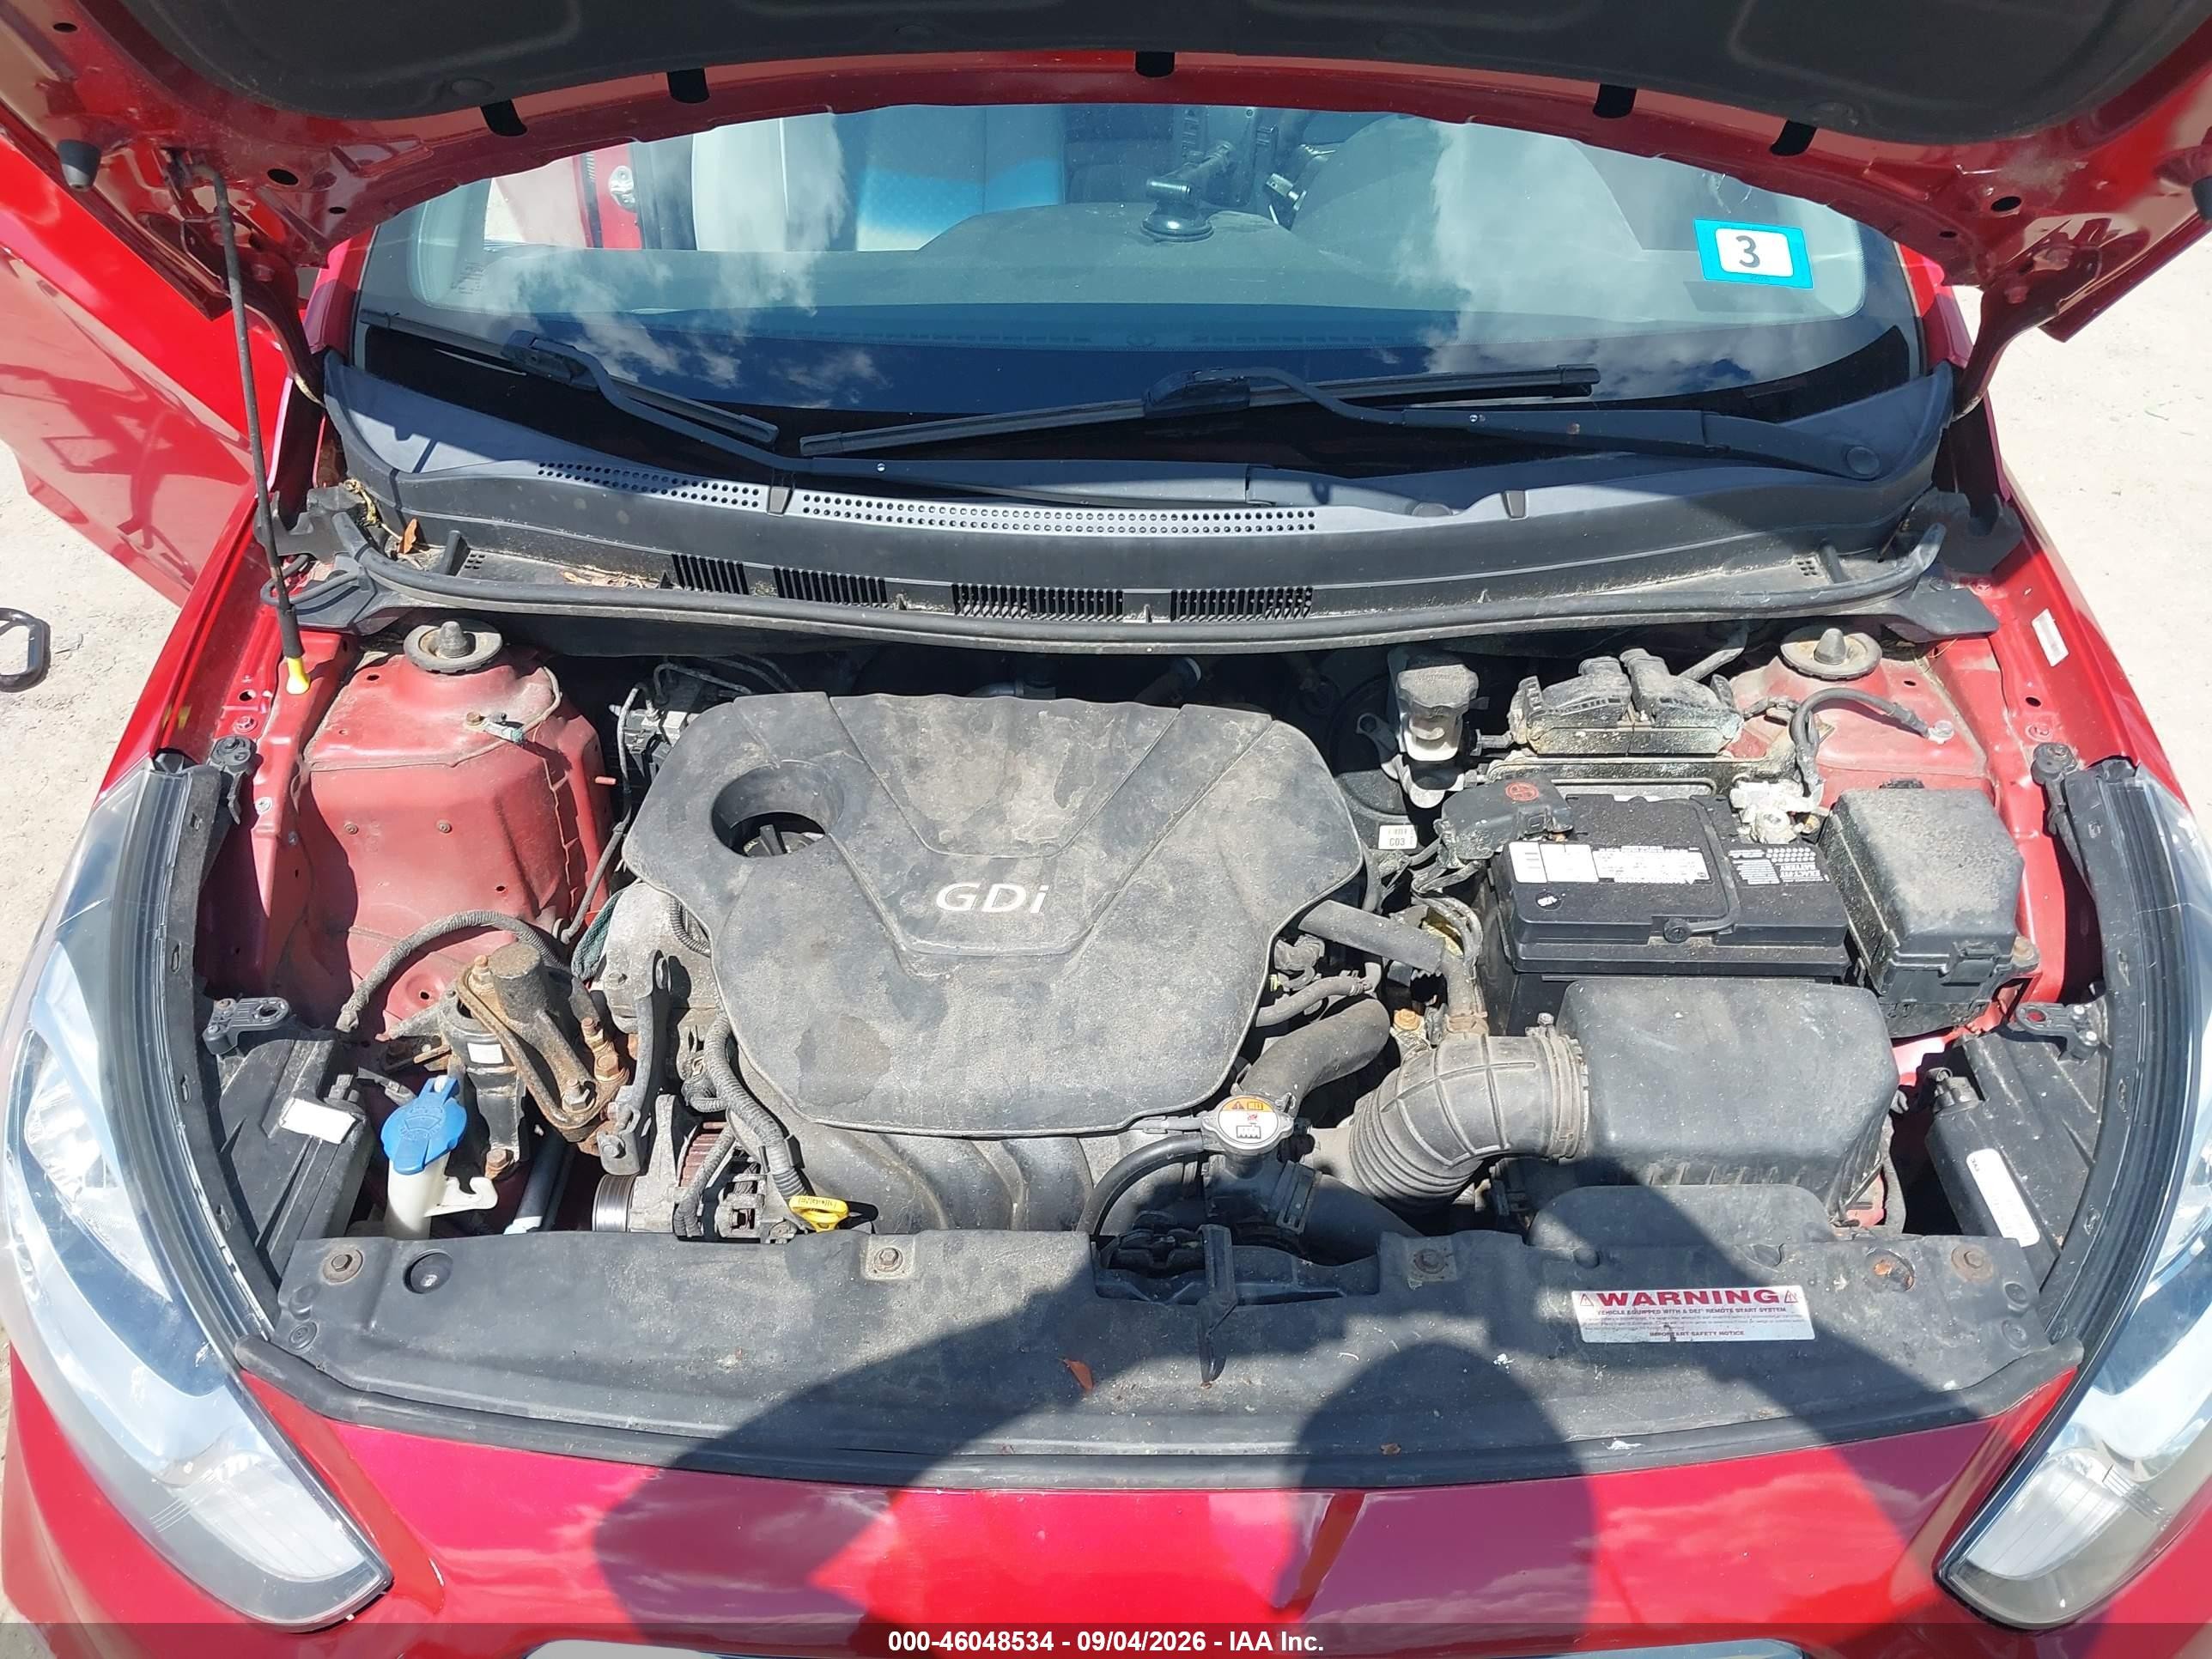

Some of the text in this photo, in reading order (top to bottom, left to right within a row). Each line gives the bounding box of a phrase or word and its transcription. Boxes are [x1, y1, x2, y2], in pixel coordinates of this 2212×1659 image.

[1735, 235, 1760, 269] 3
[1389, 837, 1406, 847] C03
[936, 882, 1050, 914] GDi
[1596, 1289, 1779, 1306] WARNING
